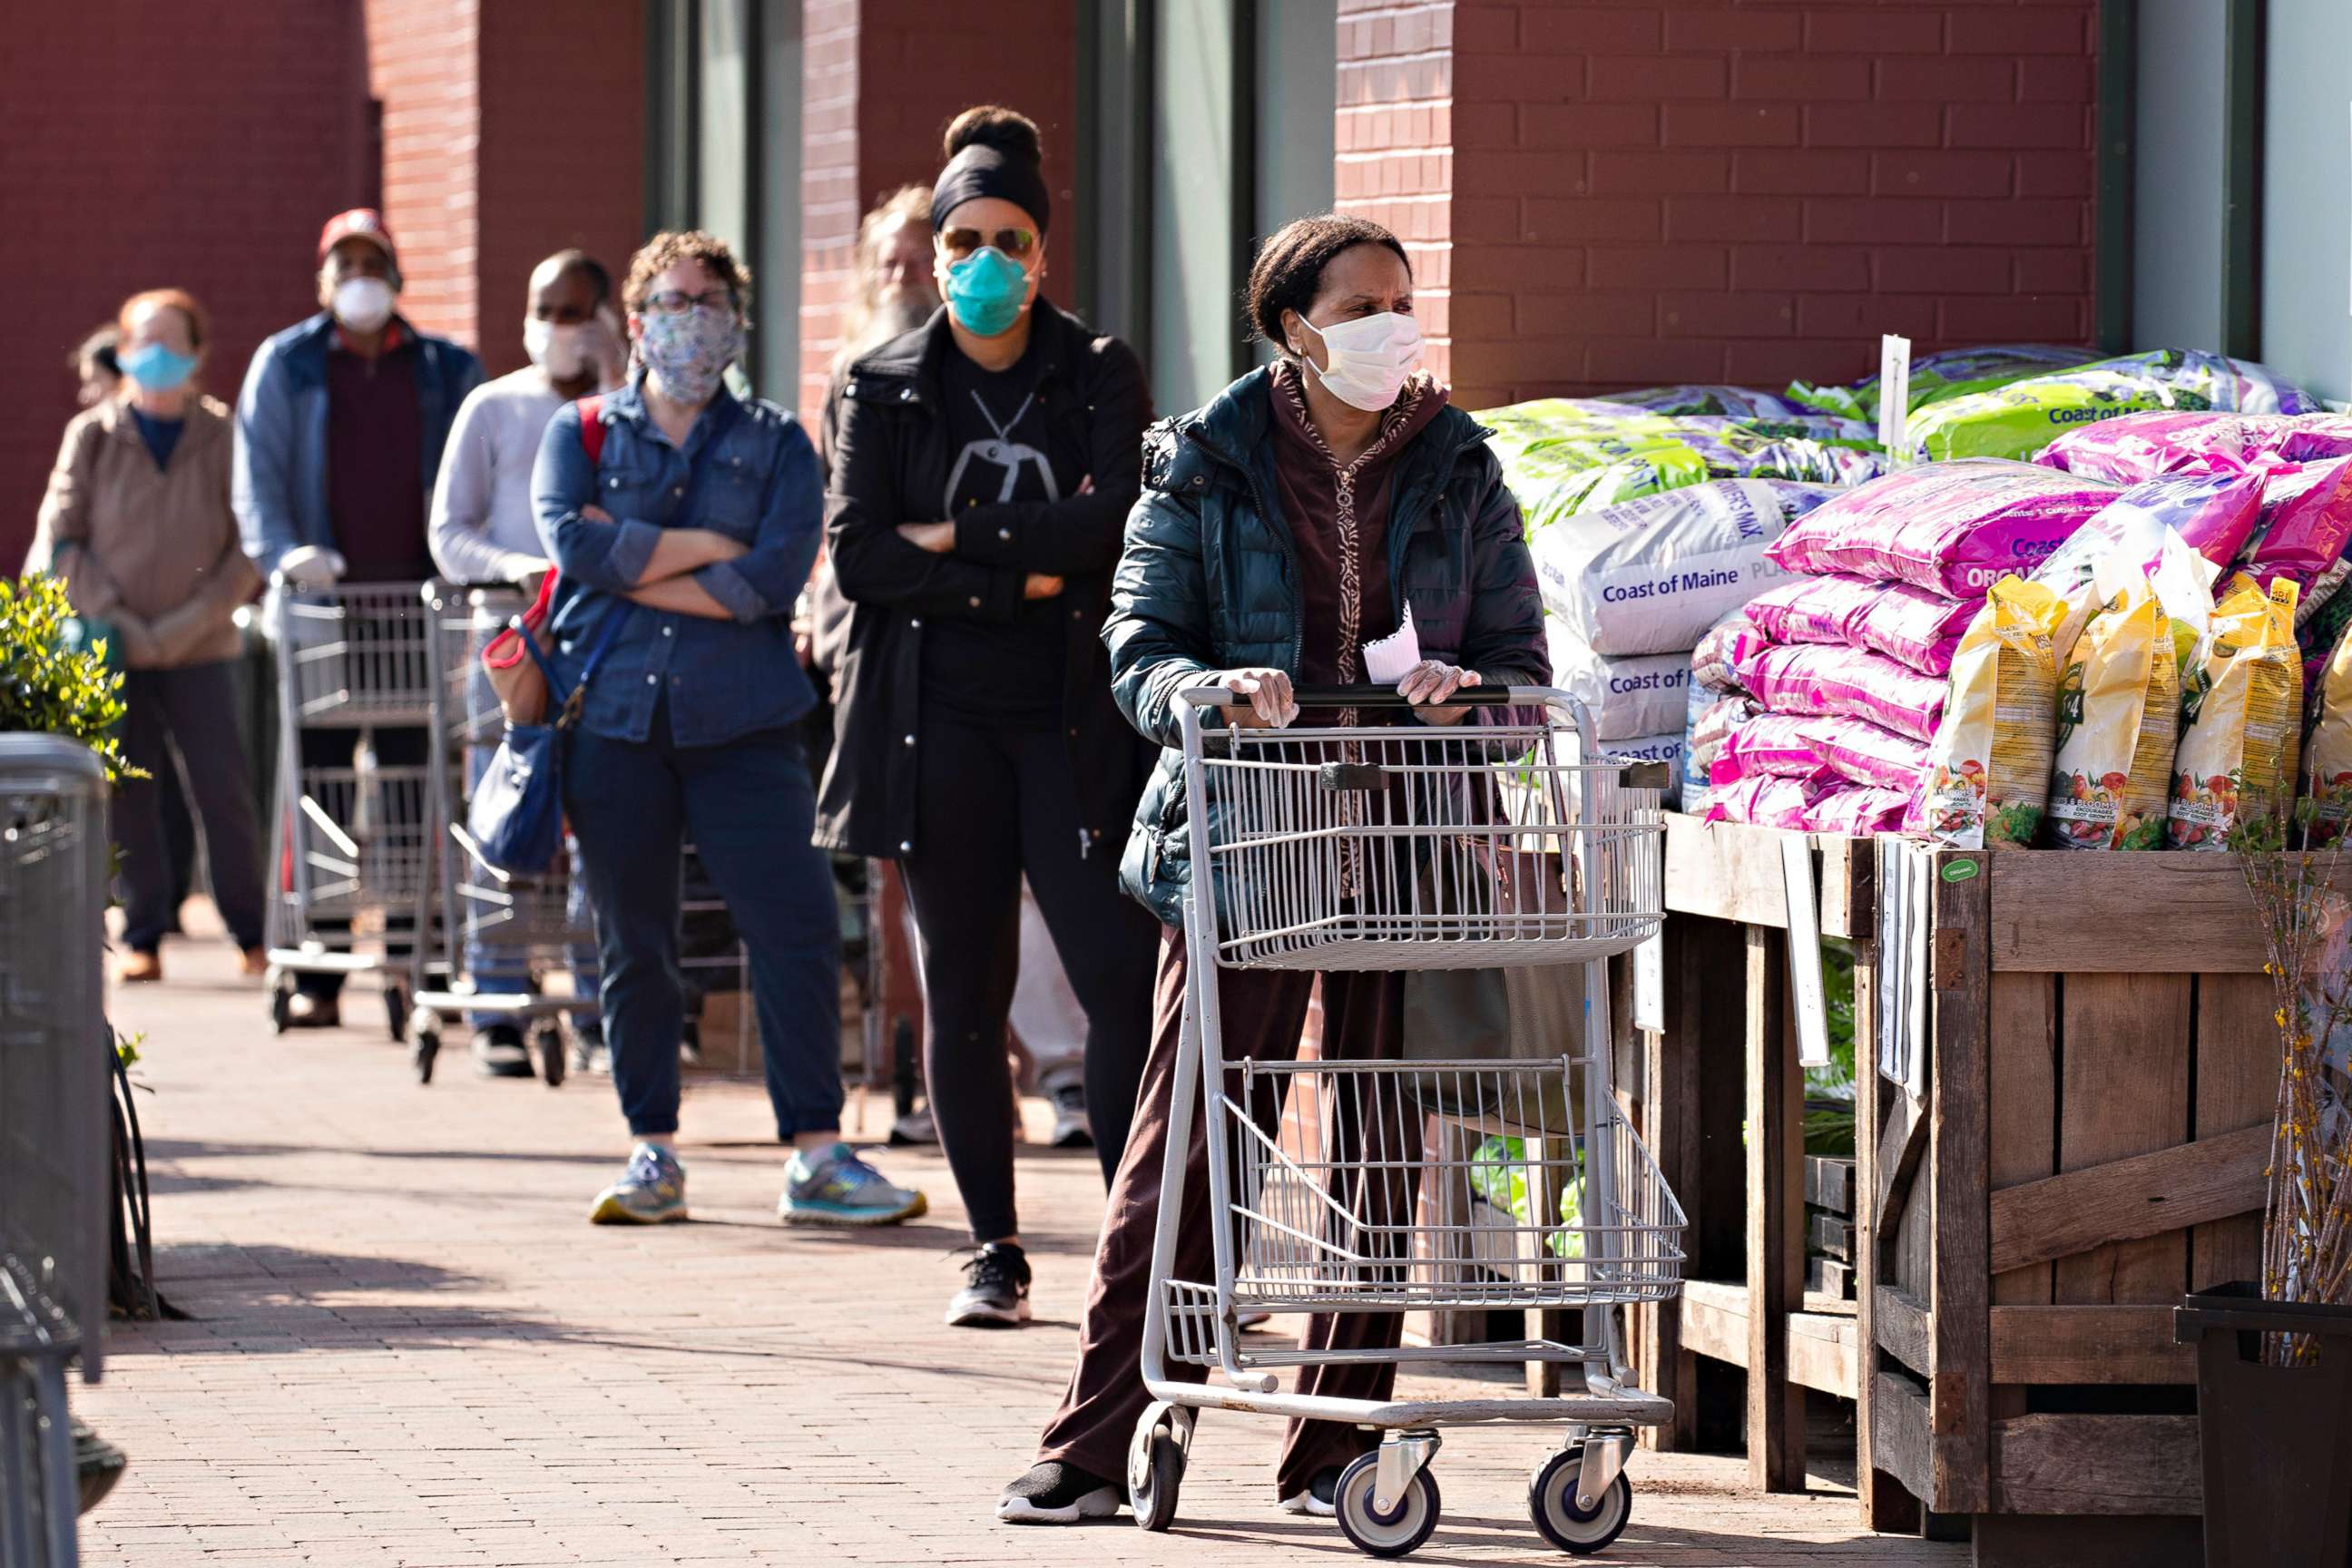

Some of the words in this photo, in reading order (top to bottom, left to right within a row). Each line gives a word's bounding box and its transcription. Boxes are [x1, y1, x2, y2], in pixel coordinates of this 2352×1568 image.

[2049, 407, 2096, 424] Coast
[2101, 406, 2119, 420] of
[1735, 511, 1763, 539] MIX
[2012, 536, 2065, 558] Coast
[1603, 581, 1654, 603] Coast
[1659, 574, 1678, 594] of
[1682, 568, 1739, 591] Maine
[1751, 561, 1787, 579] PLA
[1611, 671, 1661, 693] Coast
[1663, 669, 1684, 688] of
[1662, 742, 1681, 759] of
[2077, 799, 2116, 809] BLOOMS
[2180, 799, 2220, 811] BLOOMS
